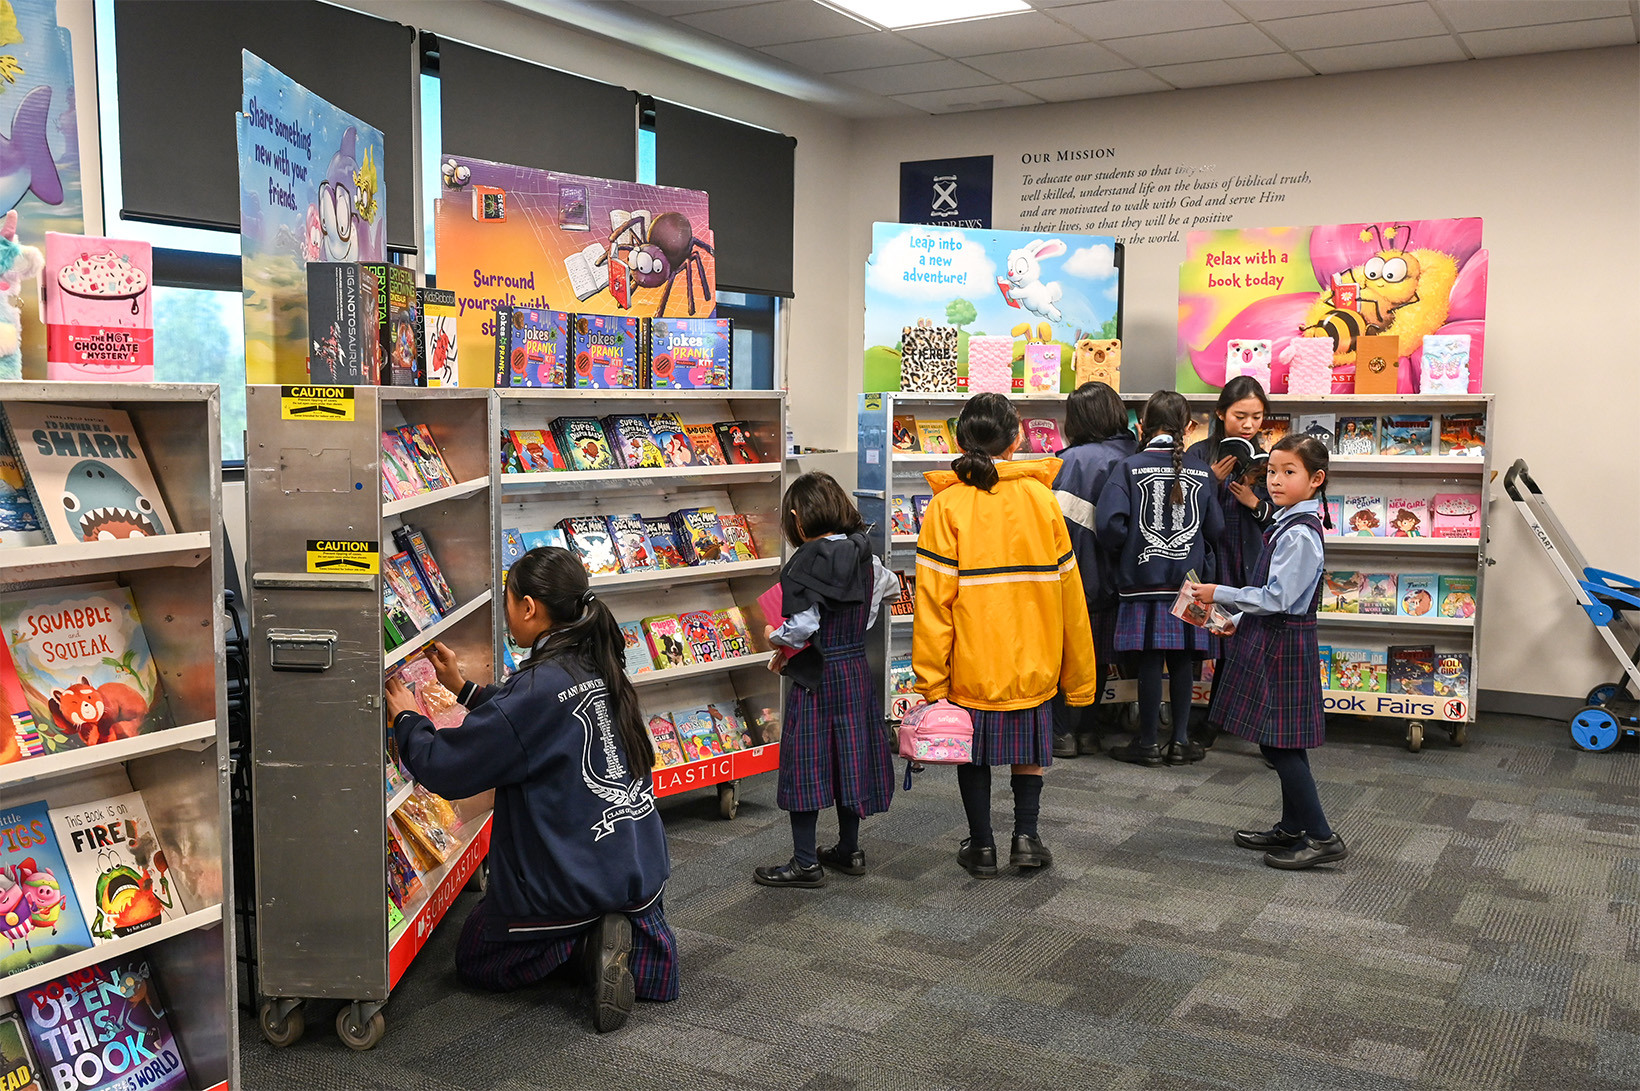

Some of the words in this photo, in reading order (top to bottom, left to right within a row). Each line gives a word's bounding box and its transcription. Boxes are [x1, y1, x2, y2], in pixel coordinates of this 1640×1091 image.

[249, 96, 274, 133] Share
[275, 119, 312, 161] something
[1022, 153, 1051, 164] OUR
[1056, 148, 1116, 161] MISSION
[255, 144, 272, 167] new
[274, 147, 290, 177] with
[291, 162, 308, 188] your
[1022, 174, 1034, 186] To
[1036, 172, 1073, 185] educate
[1074, 174, 1092, 182] our
[1094, 168, 1136, 180] students
[1137, 169, 1148, 178] so
[1150, 164, 1172, 176] that
[269, 176, 298, 211] friends.
[1021, 190, 1041, 201] well
[1042, 187, 1076, 200] skilled,
[1080, 183, 1136, 198] understand
[1138, 182, 1154, 197] life
[1158, 184, 1170, 192] on
[1174, 180, 1190, 192] the
[1194, 179, 1218, 190] basis
[1222, 176, 1236, 192] of
[1235, 174, 1278, 188] biblical
[1280, 171, 1312, 184] truth,
[1020, 206, 1040, 218] and
[1041, 208, 1057, 216] are
[1060, 201, 1110, 215] motivated
[1112, 204, 1122, 212] to
[1124, 199, 1150, 211] walk
[1152, 198, 1176, 210] with
[1180, 195, 1204, 208] God
[1205, 194, 1228, 206] and
[1229, 196, 1256, 205] serve
[1260, 192, 1286, 204] Him
[1020, 224, 1030, 232] in
[1033, 221, 1056, 232] their
[1058, 220, 1082, 232] lives,
[1086, 222, 1095, 230] so
[1098, 218, 1118, 230] that
[1121, 216, 1142, 230] they
[1145, 214, 1167, 227] will
[1168, 214, 1180, 225] be
[1192, 212, 1233, 228] positive
[910, 236, 936, 252] Leap
[939, 238, 962, 251] into
[1116, 235, 1126, 244] in
[1130, 233, 1146, 244] the
[1148, 230, 1180, 244] world.
[920, 256, 926, 266] a
[929, 256, 952, 266] new
[1206, 250, 1241, 268] Relax
[1245, 249, 1276, 264] with
[1280, 252, 1288, 264] a
[474, 268, 535, 290] Surround
[903, 267, 967, 285] adventure!
[1208, 272, 1242, 288] book
[1245, 272, 1284, 290] today
[376, 266, 387, 329] CRYSTAL
[458, 292, 516, 317] yourself
[346, 266, 358, 376] GIGANOTOSAURUS
[106, 333, 130, 342] HOT
[523, 324, 549, 344] jokes
[587, 329, 616, 348] jokes
[666, 332, 704, 350] jokes
[74, 342, 138, 352] CHOCOLATE
[526, 340, 557, 355] PRANKS
[592, 346, 624, 358] PRANKS
[674, 347, 714, 360] PRANKS
[291, 387, 345, 398] CAUTION
[59, 422, 92, 432] RATHER
[104, 424, 111, 432] A
[570, 423, 596, 432] SUPER
[620, 419, 644, 428] SUPER
[688, 426, 698, 434] BAD
[700, 426, 714, 434] GUYS
[32, 429, 138, 459] SHARK
[1356, 498, 1380, 509] CRUSH
[1389, 500, 1406, 508] NEW
[1406, 500, 1426, 509] GIRL
[612, 520, 626, 532] DOG
[626, 520, 642, 530] MAN
[644, 521, 657, 533] DOG
[657, 522, 671, 532] MAN
[687, 514, 701, 524] DOG
[702, 512, 718, 524] MAN
[572, 522, 588, 534] DOG
[588, 522, 604, 532] MAN
[1531, 524, 1554, 550] X-CART
[316, 540, 369, 552] CAUTION
[28, 606, 112, 636] SQUABBLE
[68, 630, 81, 639] and
[723, 636, 745, 651] HOT
[42, 634, 114, 662] SQUEAK
[693, 640, 714, 653] HOT
[1336, 650, 1367, 661] OFFSIDE
[1438, 660, 1462, 668] WOLF
[558, 690, 568, 702] ST
[1323, 696, 1366, 712] ook
[1377, 696, 1434, 716] Fairs
[654, 734, 670, 742] CLUB
[658, 760, 730, 790] LASTIC
[0, 814, 22, 827] ittle
[65, 814, 82, 828] This
[86, 809, 104, 824] Book
[108, 805, 116, 817] is
[116, 804, 128, 814] on
[70, 819, 138, 854] FIRE!
[426, 842, 479, 926] SCHOLASTIC
[28, 981, 64, 1010] DO
[67, 964, 104, 992] NOT
[32, 970, 126, 1028] OPEN
[40, 1009, 117, 1062] THIS
[51, 1032, 157, 1091] BOOK
[135, 1050, 180, 1088] WORLD
